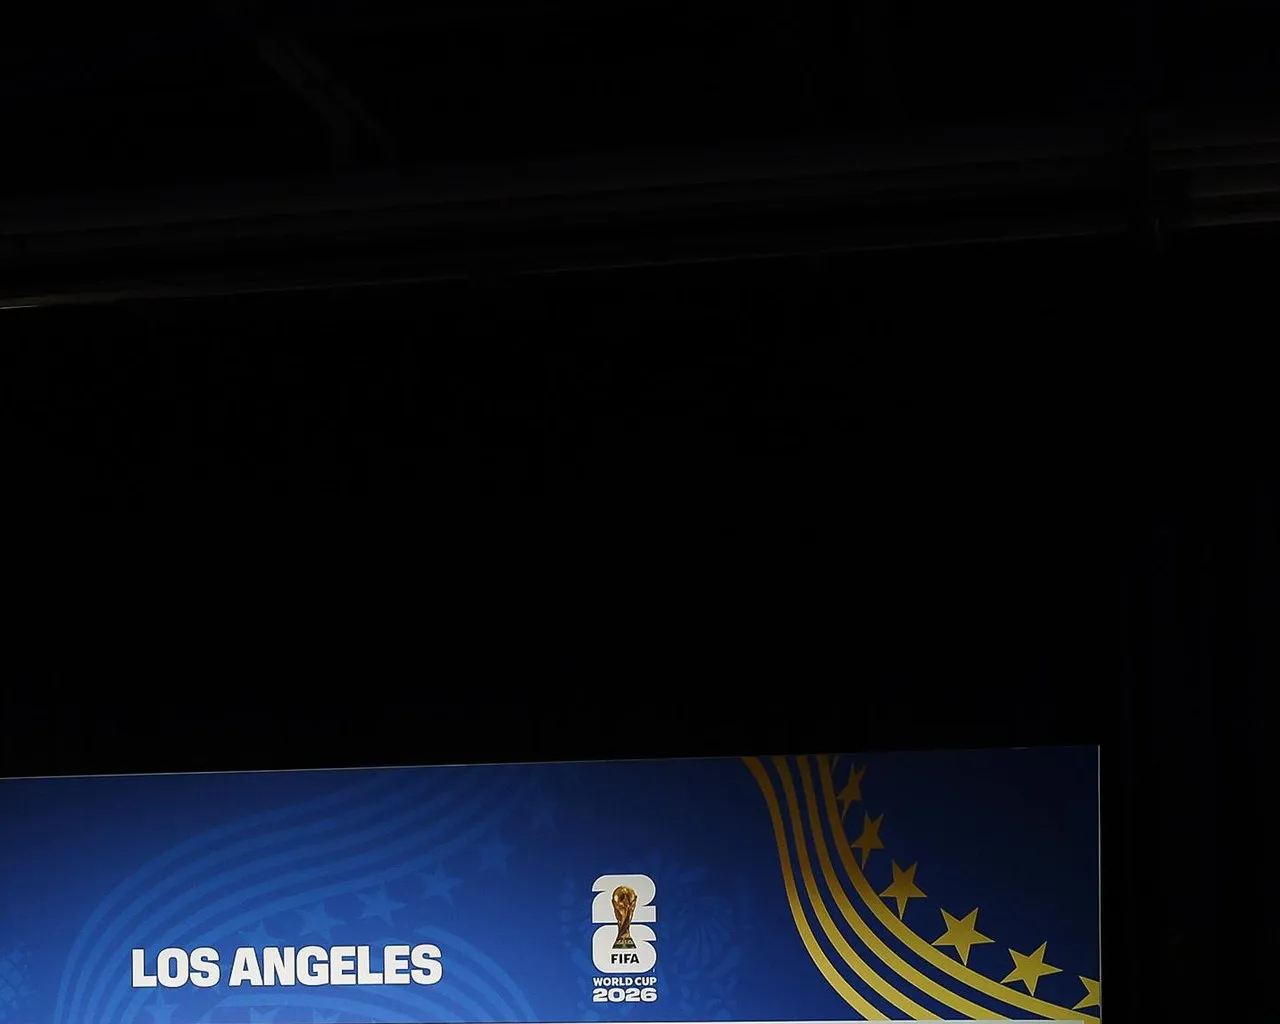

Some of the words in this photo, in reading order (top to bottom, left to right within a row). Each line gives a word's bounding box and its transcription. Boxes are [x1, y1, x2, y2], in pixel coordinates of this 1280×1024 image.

[611, 953, 639, 964] FIFA
[132, 947, 220, 987] LOS
[230, 944, 442, 986] ANGELES
[594, 977, 632, 986] WORLD
[635, 977, 657, 986] CUP
[593, 988, 657, 1002] 2026
